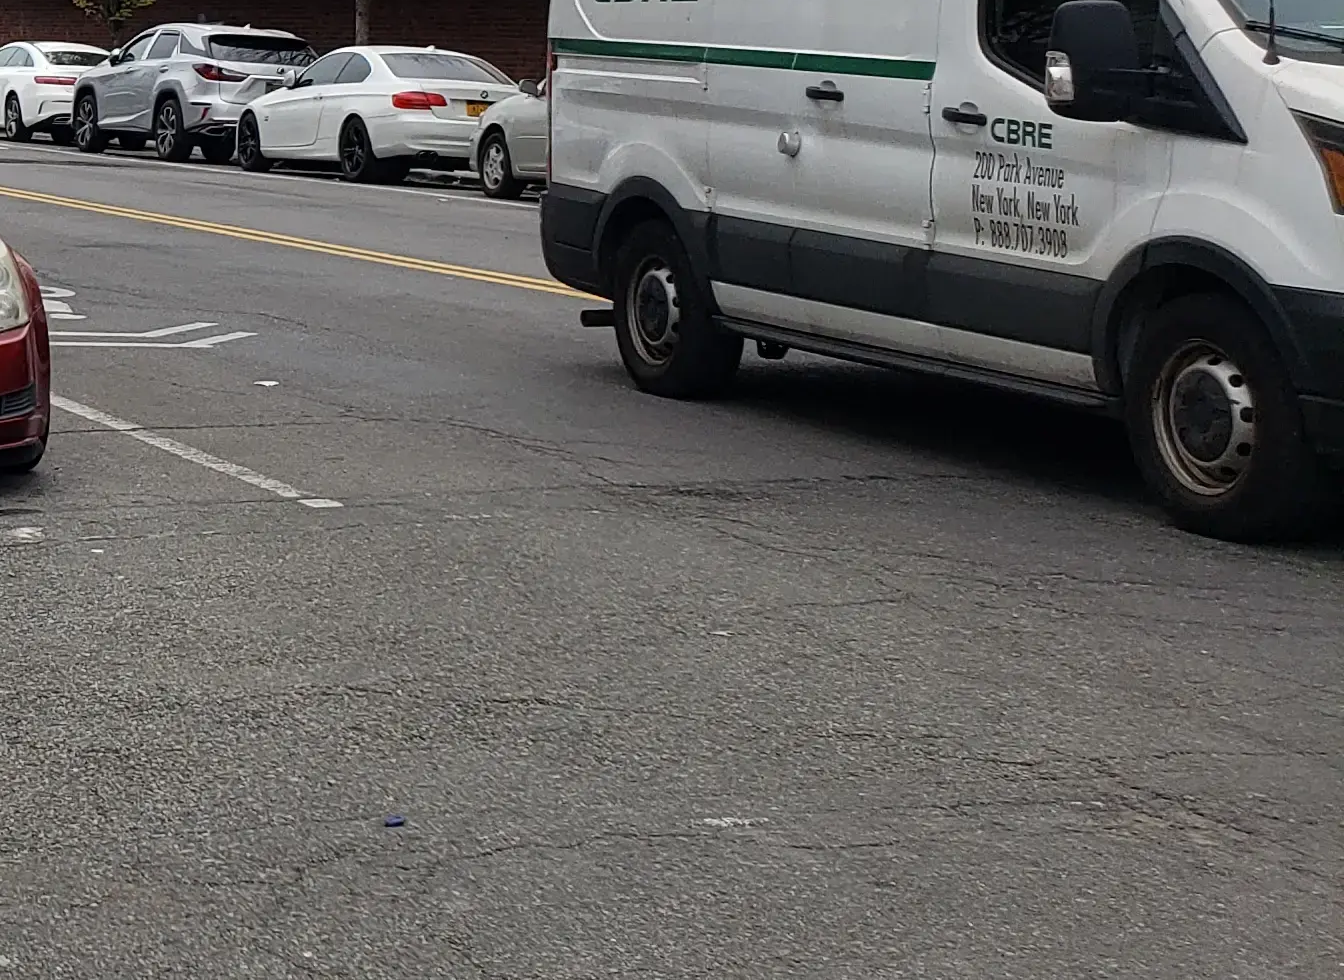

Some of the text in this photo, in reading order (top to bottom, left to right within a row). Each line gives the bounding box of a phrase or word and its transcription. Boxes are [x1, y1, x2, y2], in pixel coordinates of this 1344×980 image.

[991, 118, 1052, 149] CBRE
[973, 151, 1064, 189] 200 Park Avenue
[972, 184, 1079, 226] New York, New York
[973, 218, 1068, 258] P: 888.707.3908
